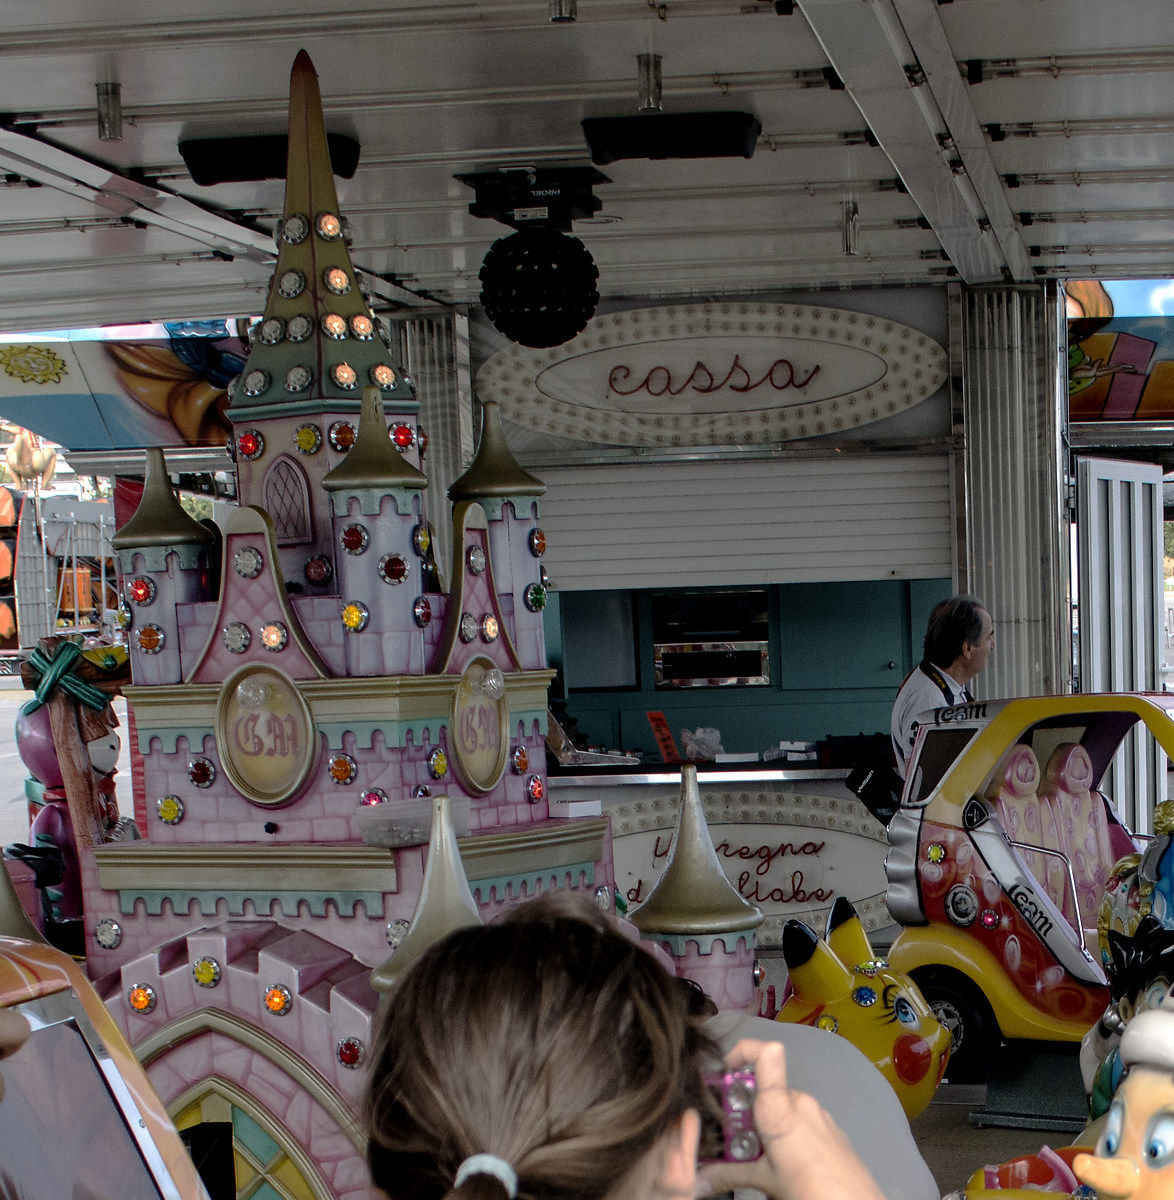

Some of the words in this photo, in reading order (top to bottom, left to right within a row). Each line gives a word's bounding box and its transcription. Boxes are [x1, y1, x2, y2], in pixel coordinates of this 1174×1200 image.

[609, 354, 821, 396] cassa
[935, 703, 987, 726] Team
[715, 838, 825, 875] regno
[1008, 883, 1054, 937] Team
